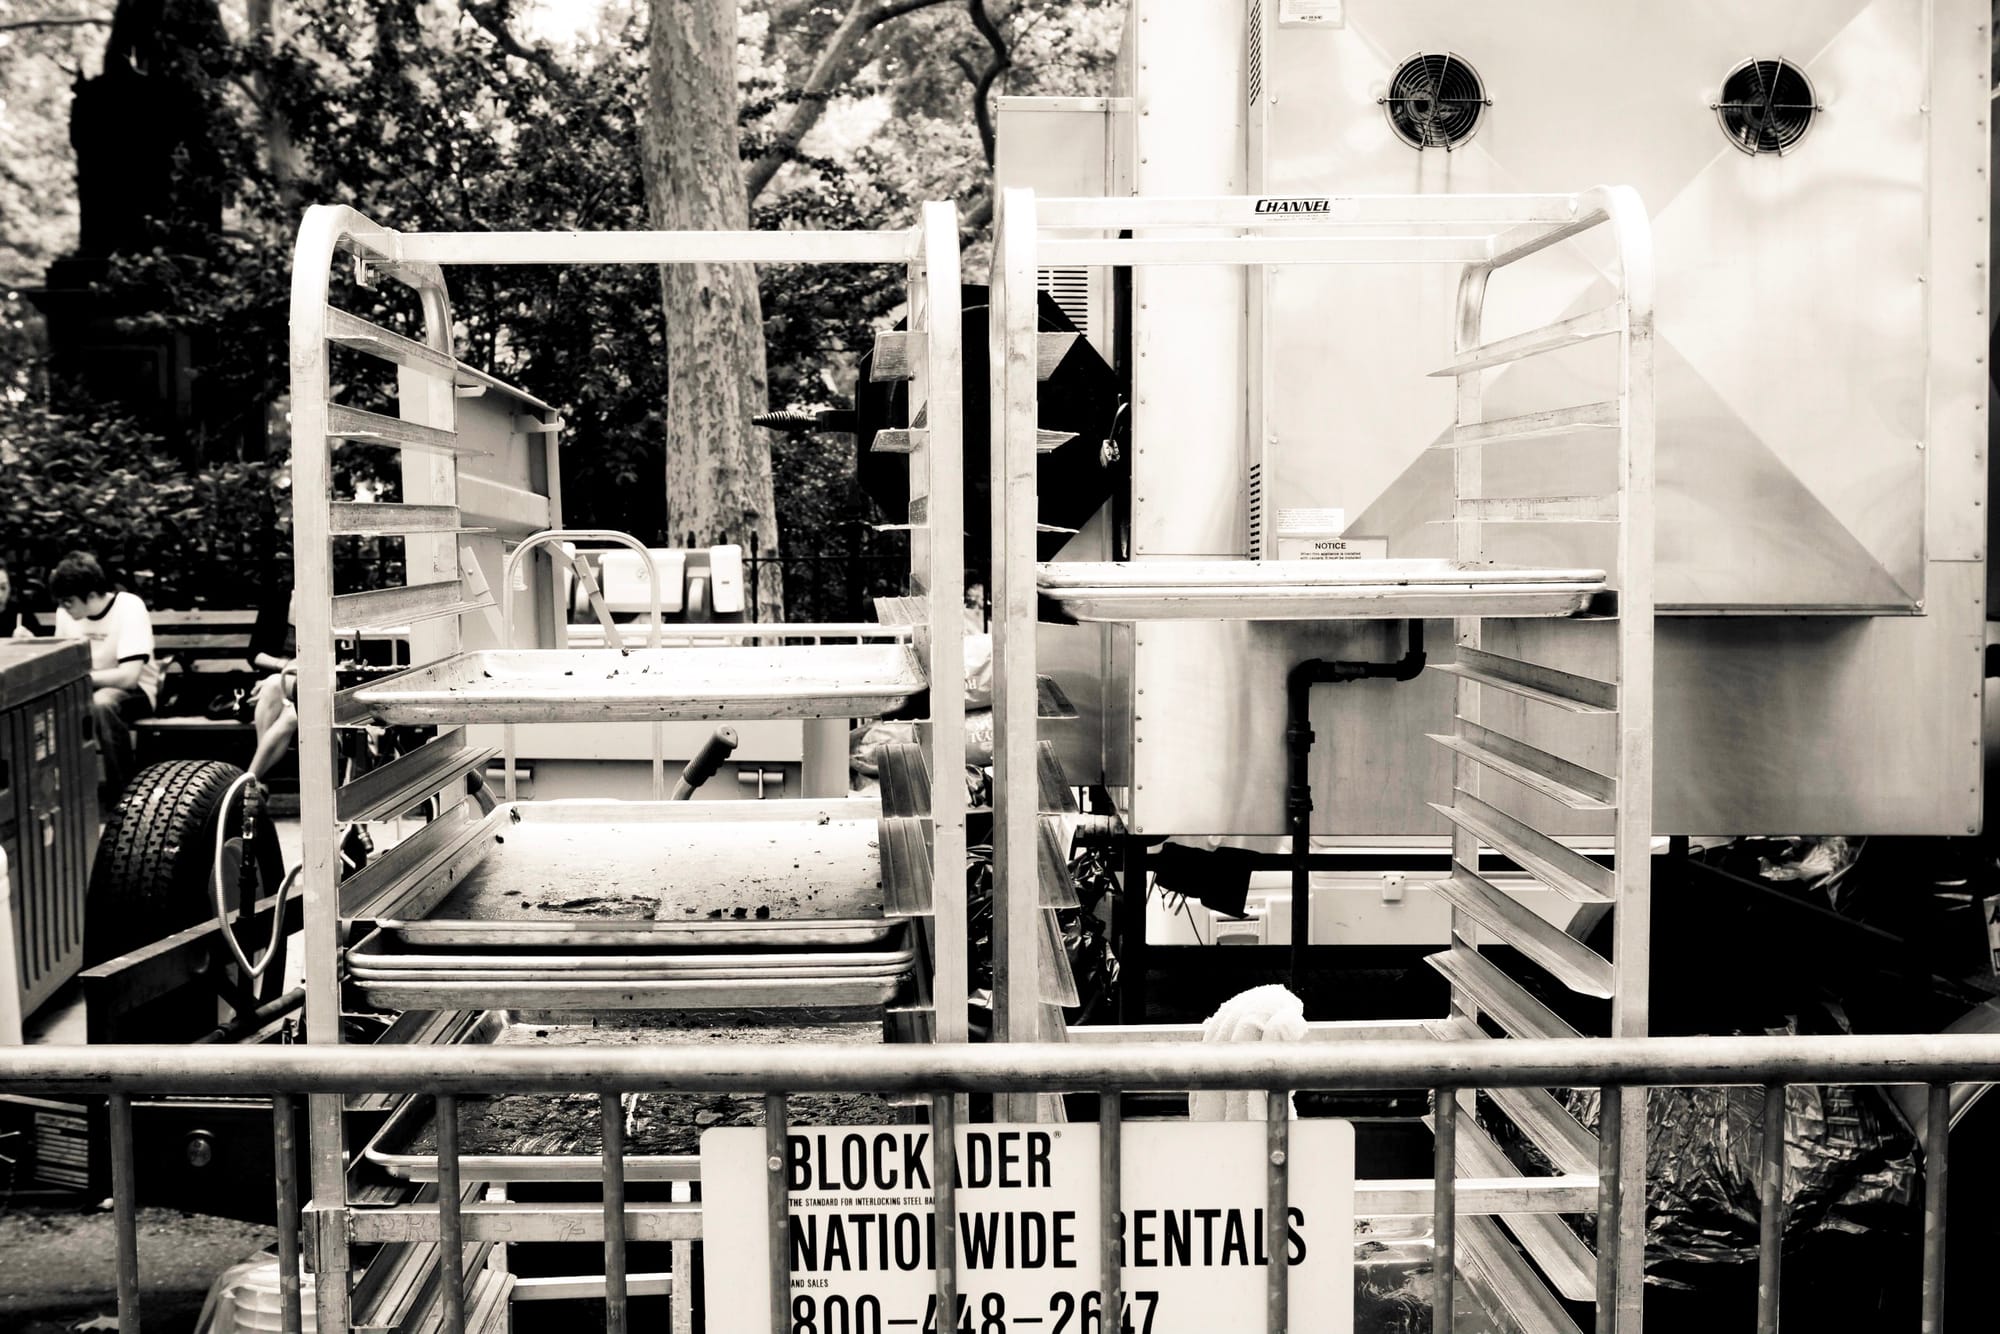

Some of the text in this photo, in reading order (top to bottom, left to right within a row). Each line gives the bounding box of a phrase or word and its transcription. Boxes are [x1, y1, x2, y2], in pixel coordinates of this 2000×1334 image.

[1255, 199, 1331, 212] CHANNEL
[1315, 542, 1346, 550] NOTICE
[789, 1198, 802, 1207] THE
[805, 1198, 838, 1207] STANDARD
[841, 1197, 853, 1206] FOR
[855, 1197, 901, 1206] INTERLOCKING
[903, 1196, 922, 1205] STEEL
[1120, 1207, 1307, 1267] ENTALS
[790, 1279, 829, 1288] AND SALES
